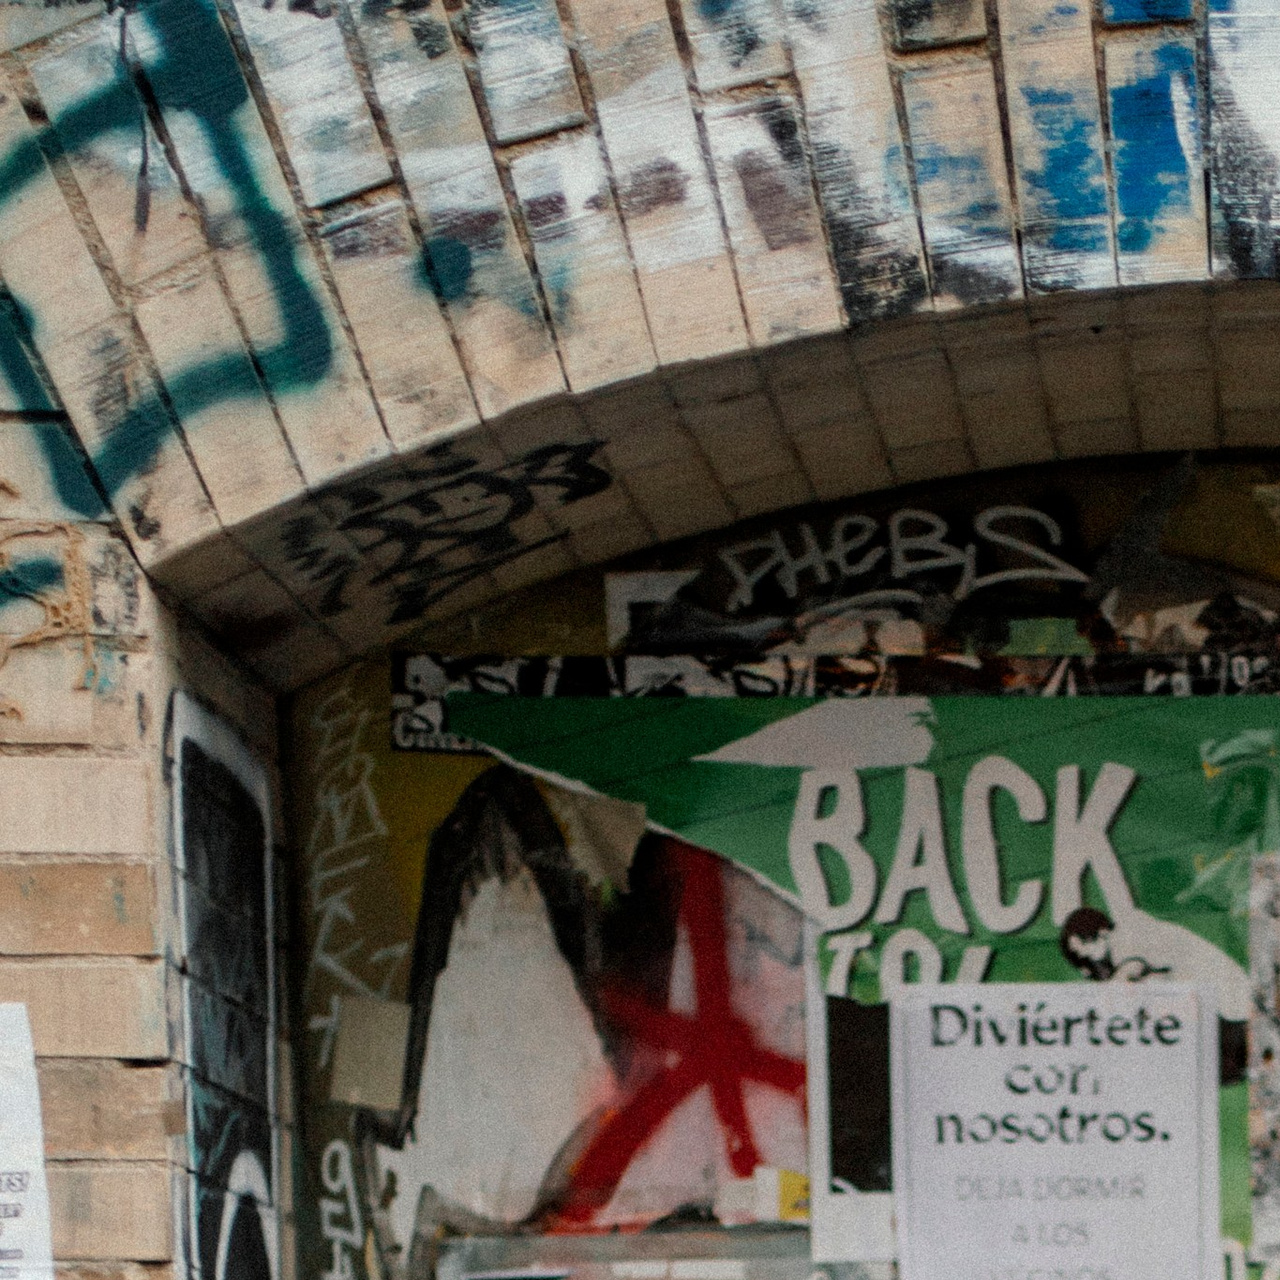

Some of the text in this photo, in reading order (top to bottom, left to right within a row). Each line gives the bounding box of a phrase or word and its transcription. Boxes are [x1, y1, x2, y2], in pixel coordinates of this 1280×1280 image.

[787, 754, 1139, 937] BACK
[930, 1001, 1184, 1049] Diviértete
[934, 1105, 1172, 1145] nosotros.
